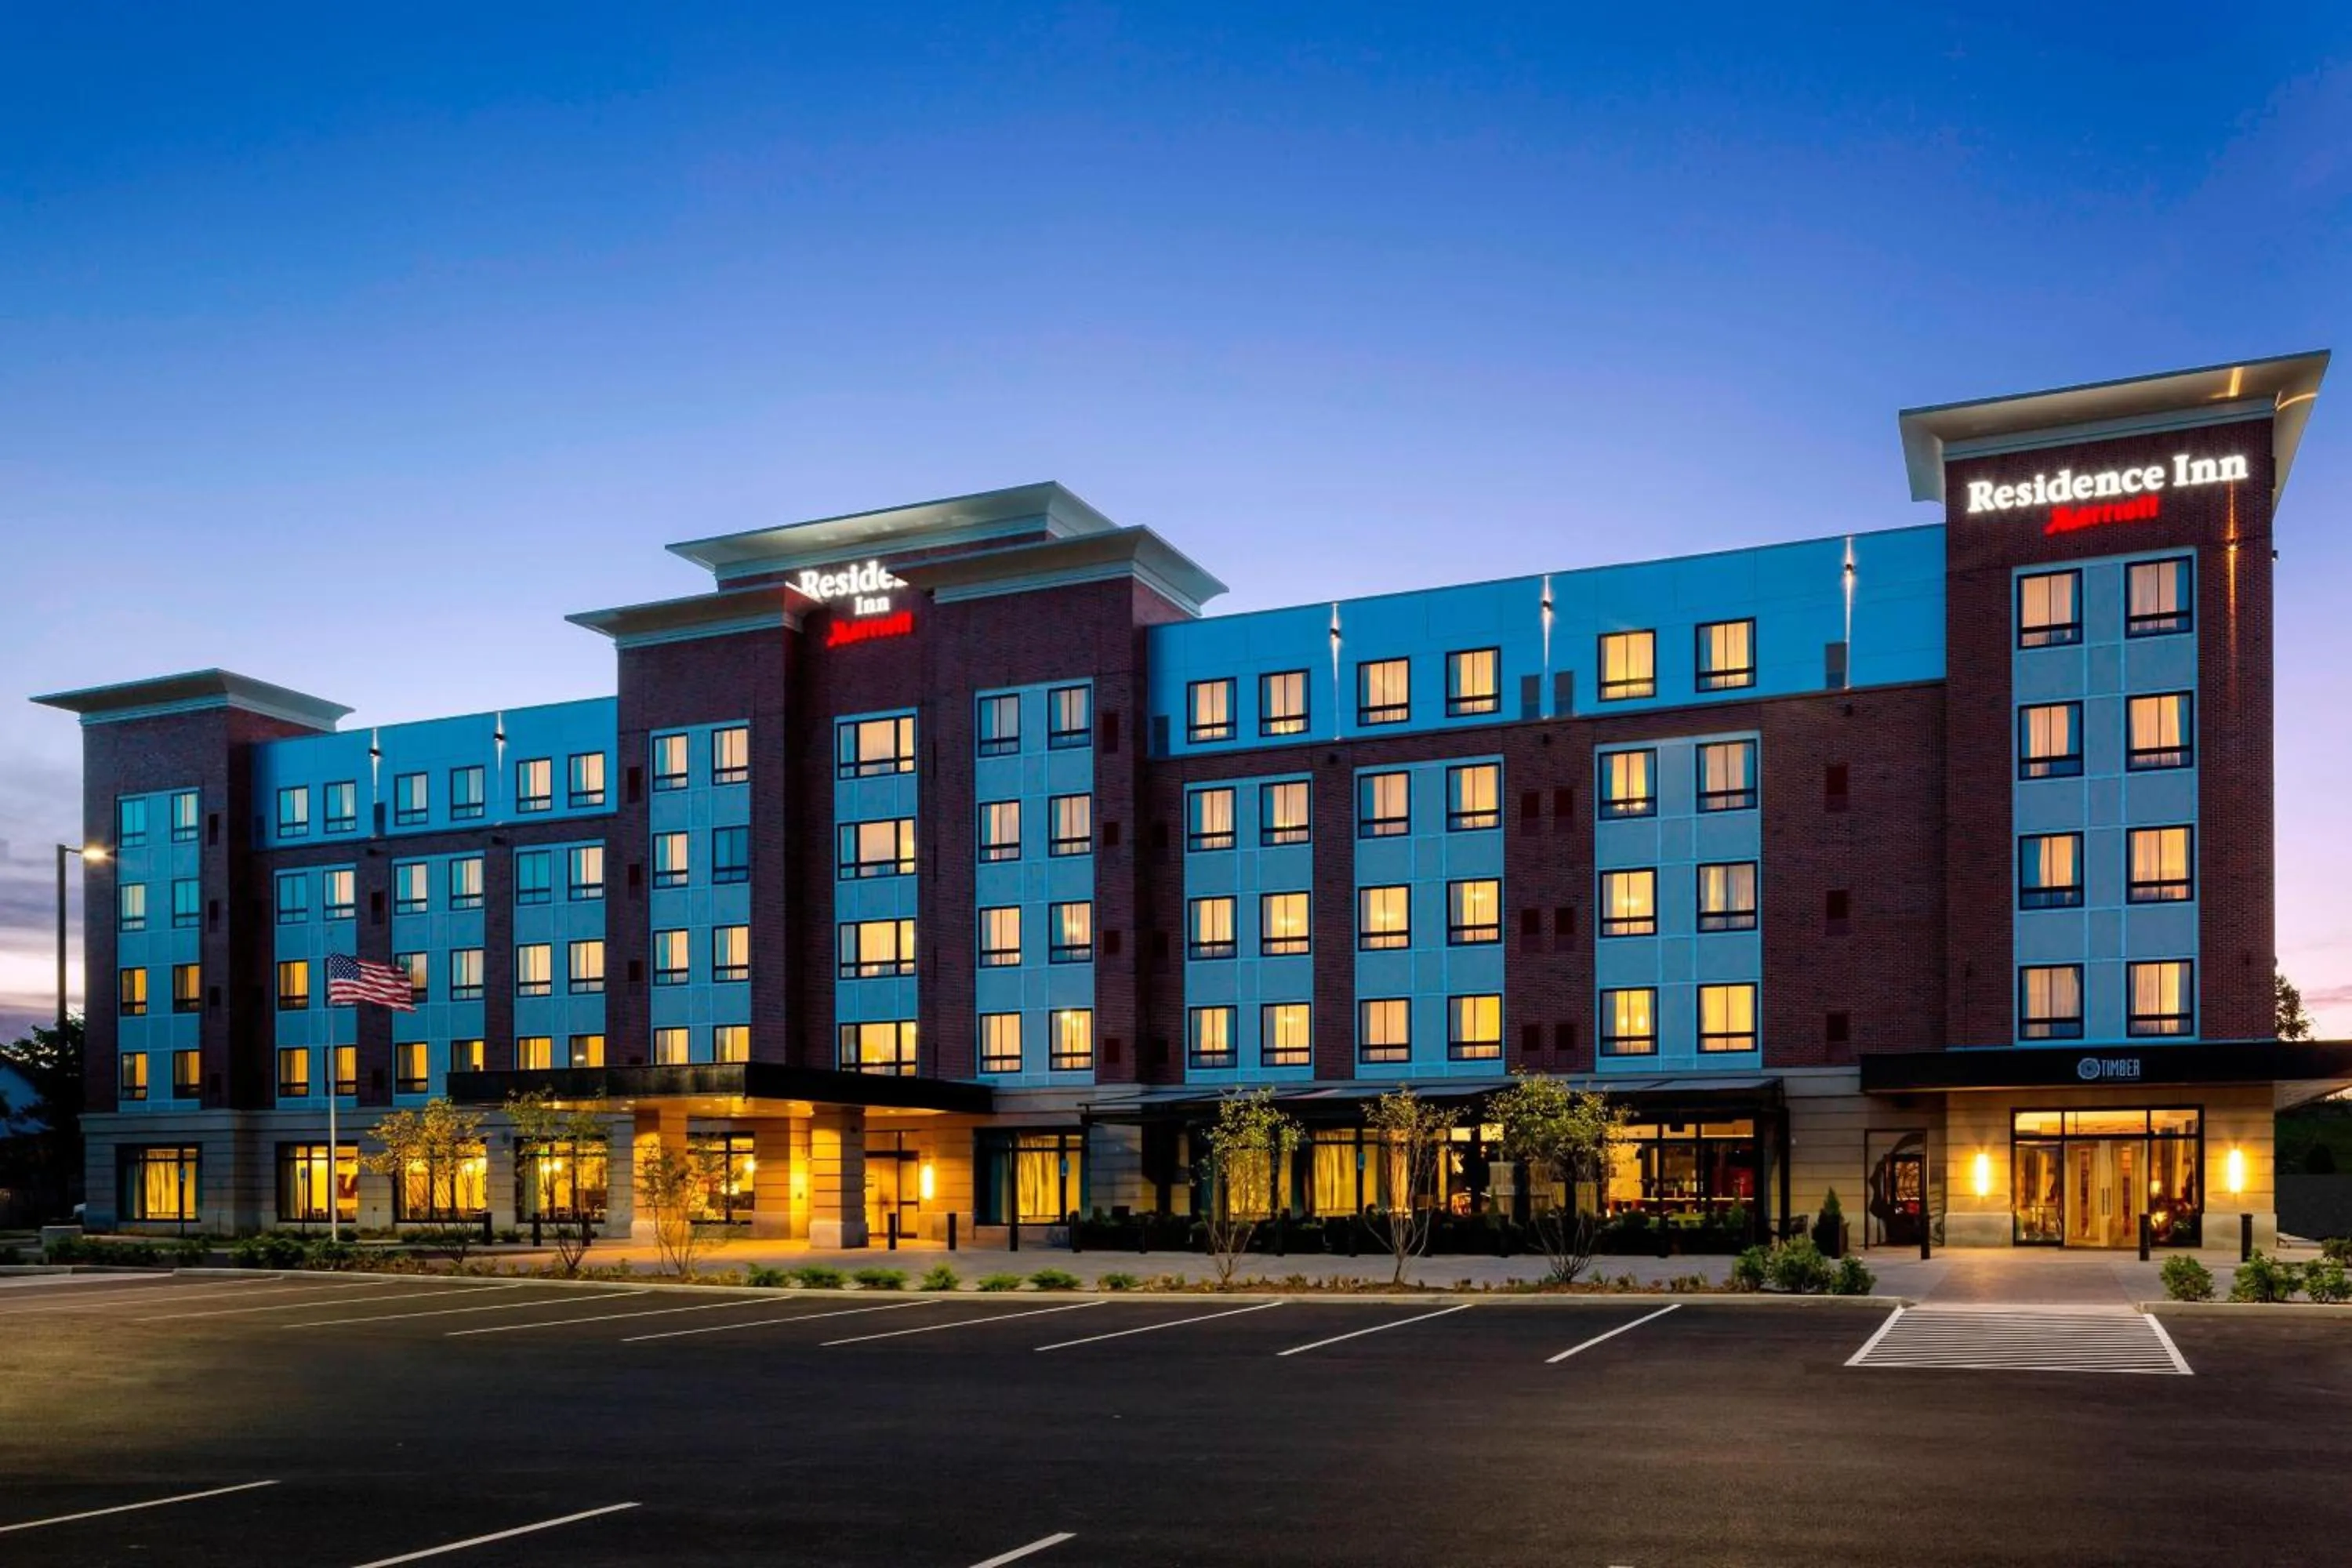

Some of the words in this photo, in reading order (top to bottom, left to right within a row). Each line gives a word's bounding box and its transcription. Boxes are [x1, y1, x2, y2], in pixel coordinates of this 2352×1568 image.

[1966, 465, 2165, 513] Residence
[2172, 453, 2249, 487] Inn
[854, 595, 891, 616] Inn
[2101, 1058, 2140, 1077] TIMBER
